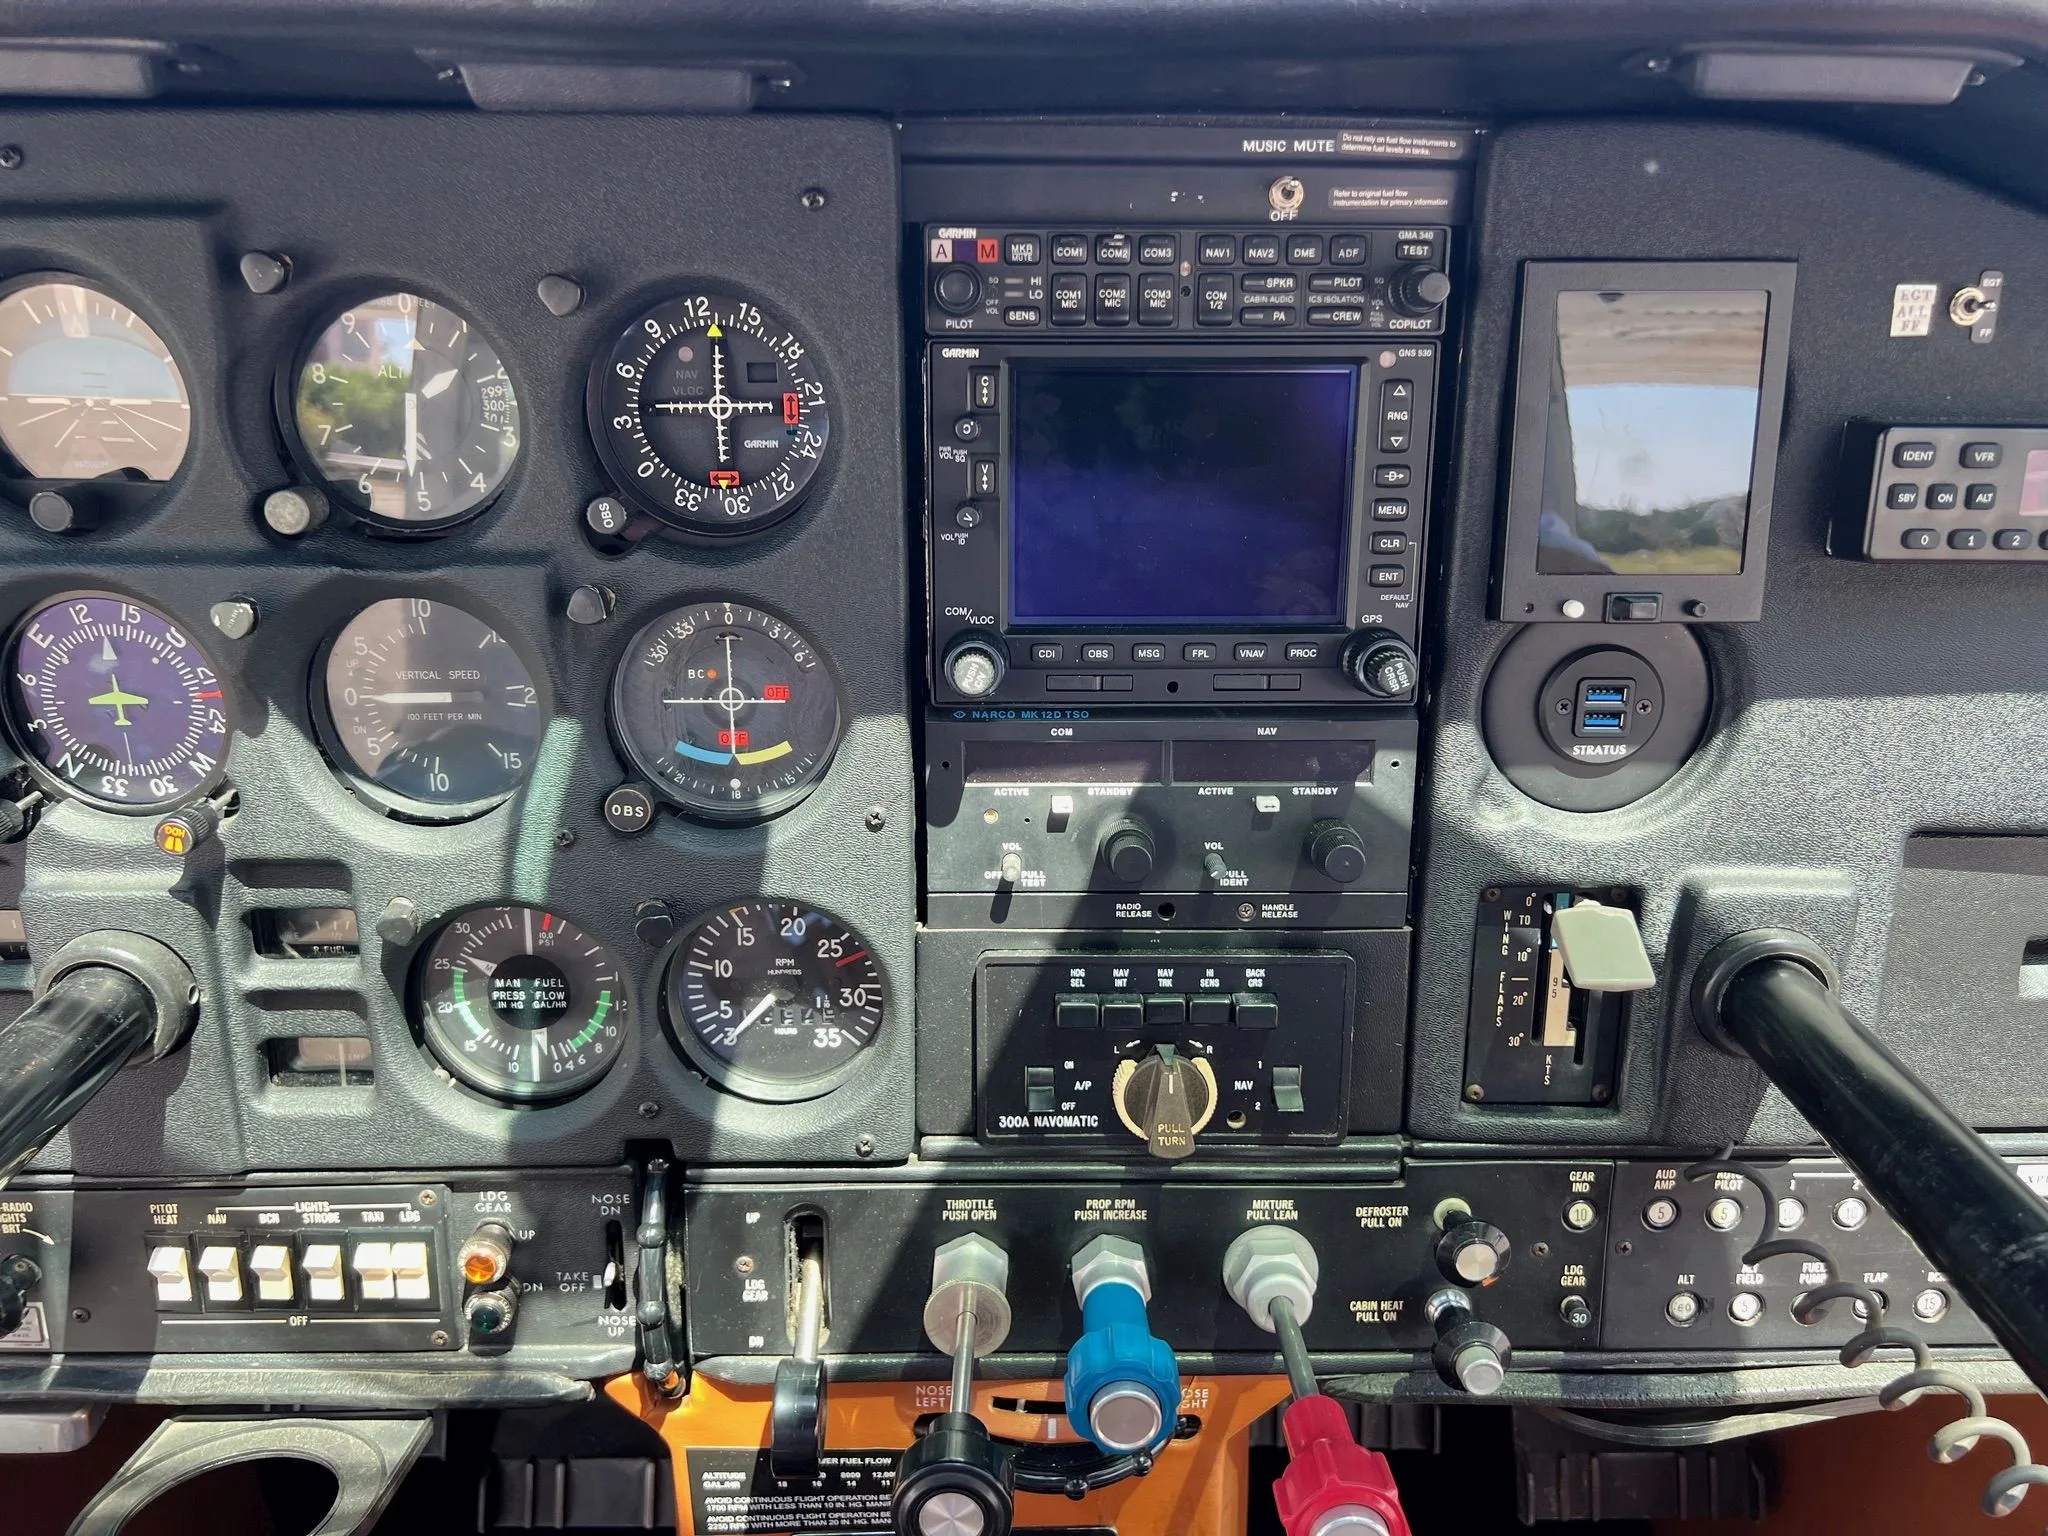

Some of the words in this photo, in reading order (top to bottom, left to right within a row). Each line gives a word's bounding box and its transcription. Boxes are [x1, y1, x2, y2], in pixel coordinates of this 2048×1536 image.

[1243, 141, 1286, 152] MUSIC
[1294, 140, 1335, 152] MUTE
[1364, 135, 1376, 144] rely
[1386, 137, 1397, 145] fuel
[1399, 137, 1411, 145] flow
[1412, 138, 1448, 148] instruments
[1341, 143, 1371, 152] determine
[1372, 145, 1384, 153] fuel
[1386, 145, 1403, 154] levels
[1270, 210, 1298, 221] OFF
[939, 228, 977, 239] GARMIN
[1398, 231, 1418, 239] GMA
[1419, 231, 1433, 239] 340
[1057, 248, 1083, 257] COM1
[1101, 249, 1128, 258] COM2
[1144, 249, 1172, 257] COM3
[1206, 248, 1230, 257] NAV1
[1249, 249, 1275, 258] NAV2
[1294, 249, 1315, 258] DME
[1339, 248, 1359, 258] ADF
[1403, 246, 1428, 256] TEST
[1266, 278, 1293, 287] SPKR
[1334, 278, 1362, 287] PILOT
[1056, 291, 1081, 299] COM1
[684, 296, 710, 318] 12
[1061, 300, 1077, 309] MIC
[739, 302, 761, 326] 15
[1009, 312, 1036, 320] SENS
[1273, 312, 1285, 321] PA
[1333, 312, 1361, 321] CREW
[946, 320, 973, 329] PILOT
[1389, 320, 1431, 329] COPILOT
[942, 348, 979, 358] GARMIN
[1399, 349, 1416, 357] GNS
[1417, 349, 1431, 357] 530
[1387, 412, 1408, 421] RNG
[744, 440, 779, 449] GARMIN
[1903, 452, 1934, 461] IDENT
[1975, 452, 1995, 461] VFR
[1898, 494, 1916, 503] SBY
[1937, 494, 1953, 503] ON
[1976, 494, 1994, 503] ALT
[1378, 505, 1406, 515] MENU
[599, 502, 614, 529] OBS
[1380, 539, 1399, 548] CLR
[1379, 573, 1398, 581] ENT
[121, 603, 142, 624] 15
[1361, 615, 1382, 623] GPS
[1038, 650, 1055, 658] CDI
[1088, 649, 1108, 659] OBS
[1138, 649, 1160, 658] MSG
[1192, 649, 1209, 658] FPL
[1239, 649, 1264, 658] VNAV
[1290, 649, 1317, 658] PROC
[396, 671, 441, 680] VERTICAL
[449, 670, 480, 680] SPEED
[1384, 666, 1400, 692] CRSR
[1394, 662, 1410, 688] PUSH
[767, 687, 789, 698] OFF
[972, 711, 1016, 719] NARCO
[1021, 711, 1038, 719] MK
[1041, 711, 1061, 719] 12D
[1065, 711, 1089, 719] TSO
[1050, 728, 1073, 736] COM
[1572, 744, 1627, 755] STRATUS
[1198, 787, 1234, 795] ACTIVE
[1292, 787, 1338, 795] STANDBY
[612, 805, 644, 817] OBS
[1220, 878, 1249, 886] IDENT
[1116, 910, 1152, 918] RELEASE
[1519, 915, 1530, 925] TO
[780, 918, 806, 937] 20
[817, 939, 843, 958] 25
[775, 959, 795, 967] RPM
[1070, 968, 1085, 978] HDG
[1113, 968, 1130, 978] NAV
[1157, 968, 1174, 978] NAV
[1245, 968, 1266, 977] BACK
[495, 979, 521, 988] MAN
[534, 978, 564, 988] FUEL
[1070, 978, 1085, 988] SEL
[1115, 978, 1127, 988] INT
[1158, 978, 1172, 988] TRK
[1200, 978, 1220, 988] SENS
[1248, 978, 1263, 988] CRS
[492, 991, 526, 1000] PRESS
[536, 991, 565, 1000] FLOW
[498, 1001, 507, 1009] IN
[533, 1001, 567, 1009] GAL/HR
[1074, 1080, 1092, 1091] A/P
[1234, 1080, 1253, 1091] NAV
[1062, 1102, 1076, 1111] OFF
[999, 1116, 1030, 1128] 300A
[1034, 1115, 1098, 1128] NAVOMATIC
[1158, 1124, 1185, 1134] PULL
[1158, 1136, 1186, 1146] TURN
[1569, 1171, 1595, 1182] GEAR
[1655, 1169, 1676, 1179] AUD
[1572, 1183, 1589, 1192] IND
[1654, 1180, 1676, 1190] AMP
[480, 1192, 508, 1201] LDG
[592, 1194, 630, 1204] NOSE
[150, 1204, 178, 1214] PITOT
[294, 1202, 330, 1212] LIGHTS
[474, 1203, 512, 1212] GEAR
[946, 1199, 994, 1210] THROTTLE
[1086, 1199, 1112, 1209] PROP
[1115, 1199, 1136, 1209] RPM
[1252, 1200, 1294, 1210] MIXTURE
[601, 1206, 620, 1215] DN
[943, 1210, 968, 1220] PUSH
[971, 1210, 997, 1220] OPEN
[1075, 1210, 1100, 1220] PUSH
[1103, 1210, 1147, 1220] INCREASE
[1247, 1210, 1270, 1220] PULL
[1274, 1210, 1298, 1220] LEAN
[1355, 1206, 1409, 1218] DEFROSTER
[153, 1215, 178, 1225] HEAT
[1361, 1218, 1384, 1228] PULL
[1388, 1217, 1402, 1227] ON
[520, 1230, 536, 1239] UP
[1564, 1265, 1584, 1275] LDG
[556, 1272, 589, 1281] TAKE
[1560, 1276, 1585, 1286] GEAR
[1677, 1275, 1695, 1284] ALT
[522, 1283, 543, 1292] DN
[559, 1283, 585, 1292] OFF
[1350, 1301, 1378, 1311] CABIN
[1381, 1300, 1404, 1311] HEAT
[289, 1316, 308, 1326] OFF
[598, 1316, 637, 1326] NOSE
[1356, 1312, 1380, 1322] PULL
[1383, 1311, 1397, 1321] ON
[1572, 1313, 1586, 1323] 30
[608, 1327, 625, 1337] UP
[916, 1397, 946, 1408] LEFT
[840, 1457, 864, 1465] FUEL
